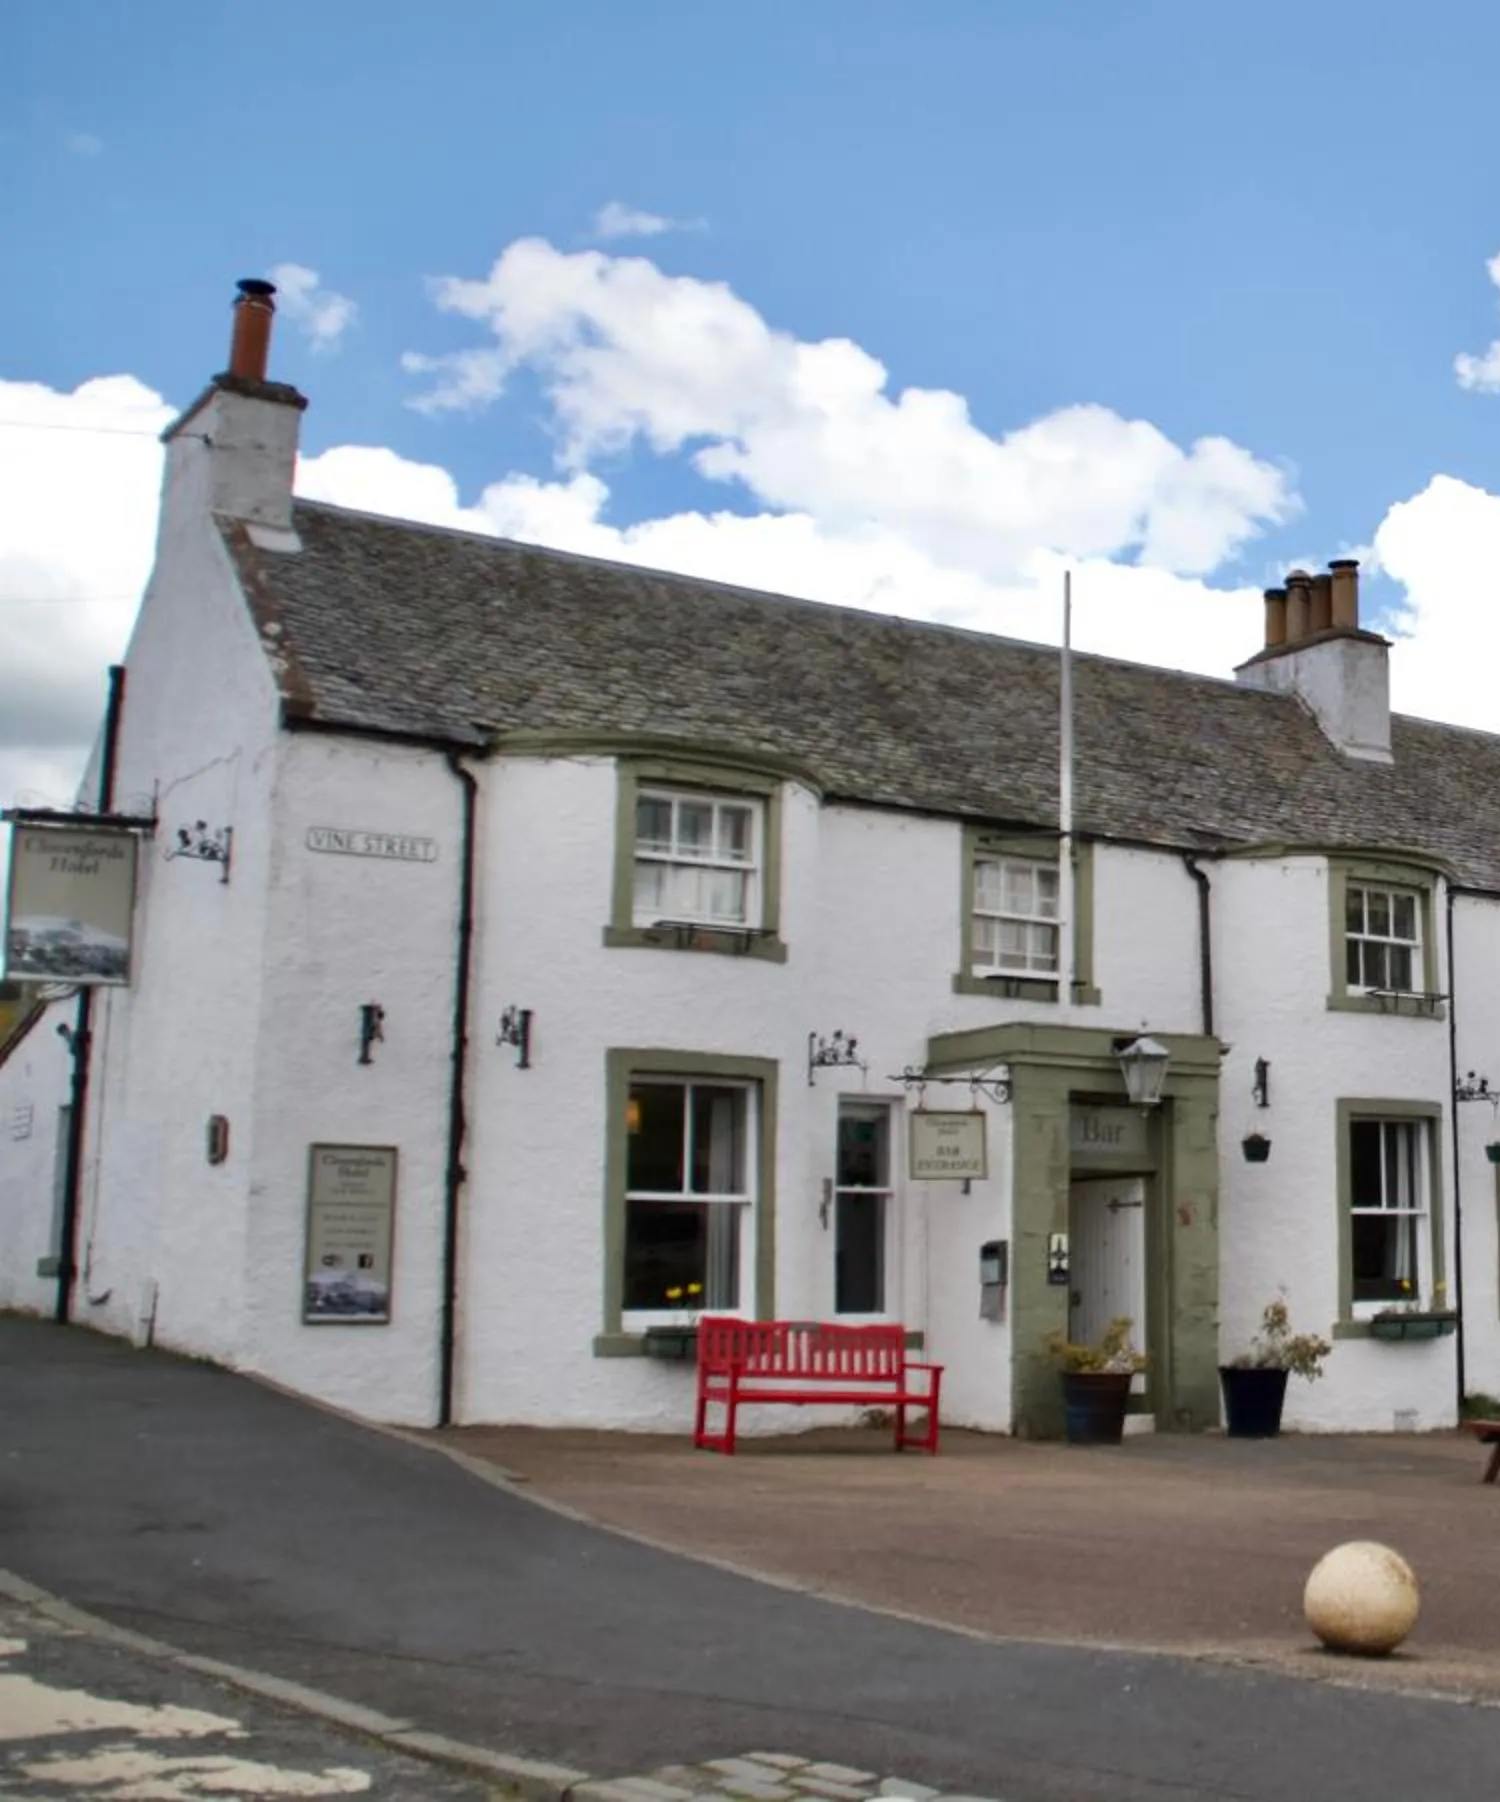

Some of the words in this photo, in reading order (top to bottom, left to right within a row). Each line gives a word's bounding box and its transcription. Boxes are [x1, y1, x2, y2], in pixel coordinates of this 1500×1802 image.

[313, 831, 353, 851] VINE
[364, 836, 432, 859] STREET
[1081, 1116, 1127, 1144] Bar
